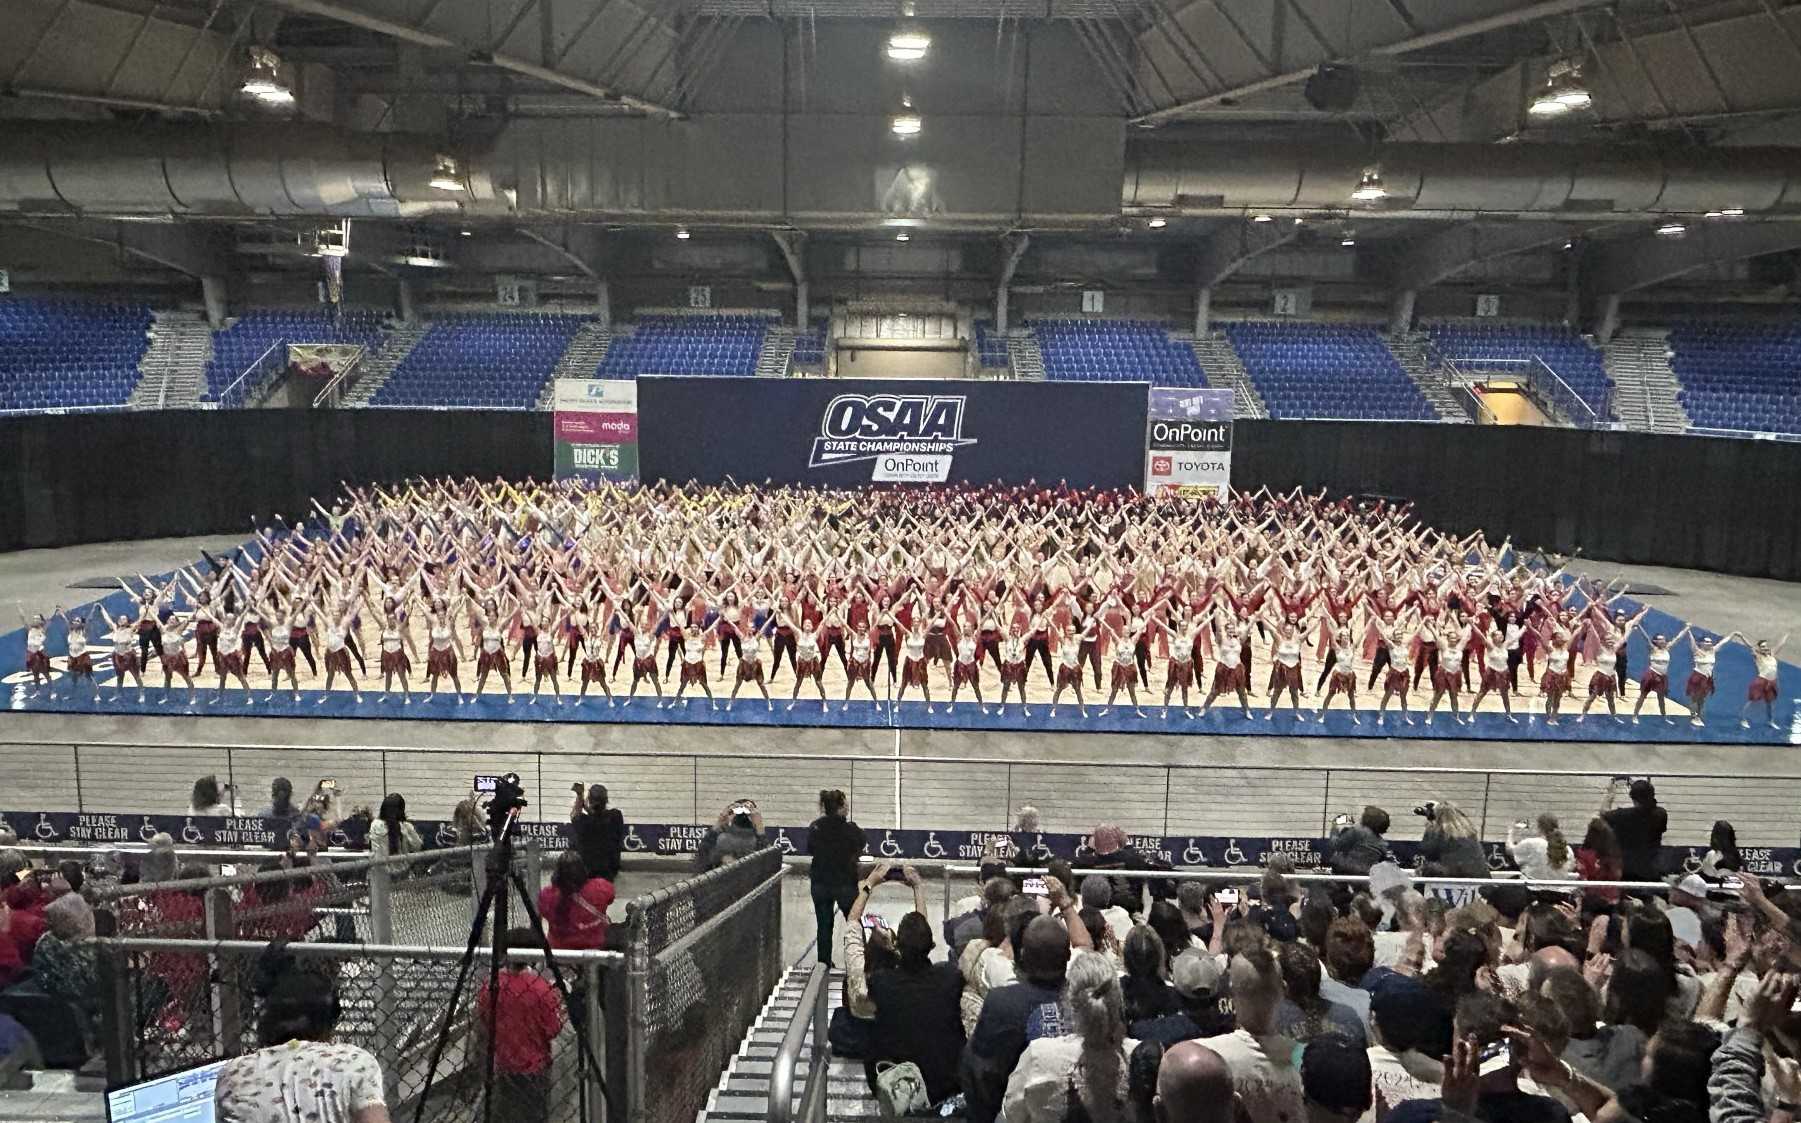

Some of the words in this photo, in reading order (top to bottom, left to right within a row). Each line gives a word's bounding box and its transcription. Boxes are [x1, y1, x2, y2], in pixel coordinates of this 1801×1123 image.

[824, 396, 965, 440] OSAA
[1153, 423, 1226, 442] OnPoint
[824, 441, 858, 451] STATE
[858, 441, 954, 453] CHAMPIONSHIPS
[573, 448, 619, 466] DICK'S
[884, 458, 940, 472] OnPoint
[1178, 462, 1225, 472] TOYOTA
[78, 815, 117, 827] PLEASE
[225, 818, 265, 830] PLEASE
[69, 826, 92, 839] STAY
[94, 827, 129, 840] CLEAR
[214, 830, 238, 843] STAY
[242, 831, 276, 844] CLEAR
[520, 824, 559, 837] PLEASE
[658, 838, 683, 851] STAY
[958, 844, 984, 857] STAY
[1271, 839, 1311, 852] PLEASE
[1747, 861, 1784, 873] CLEAR
